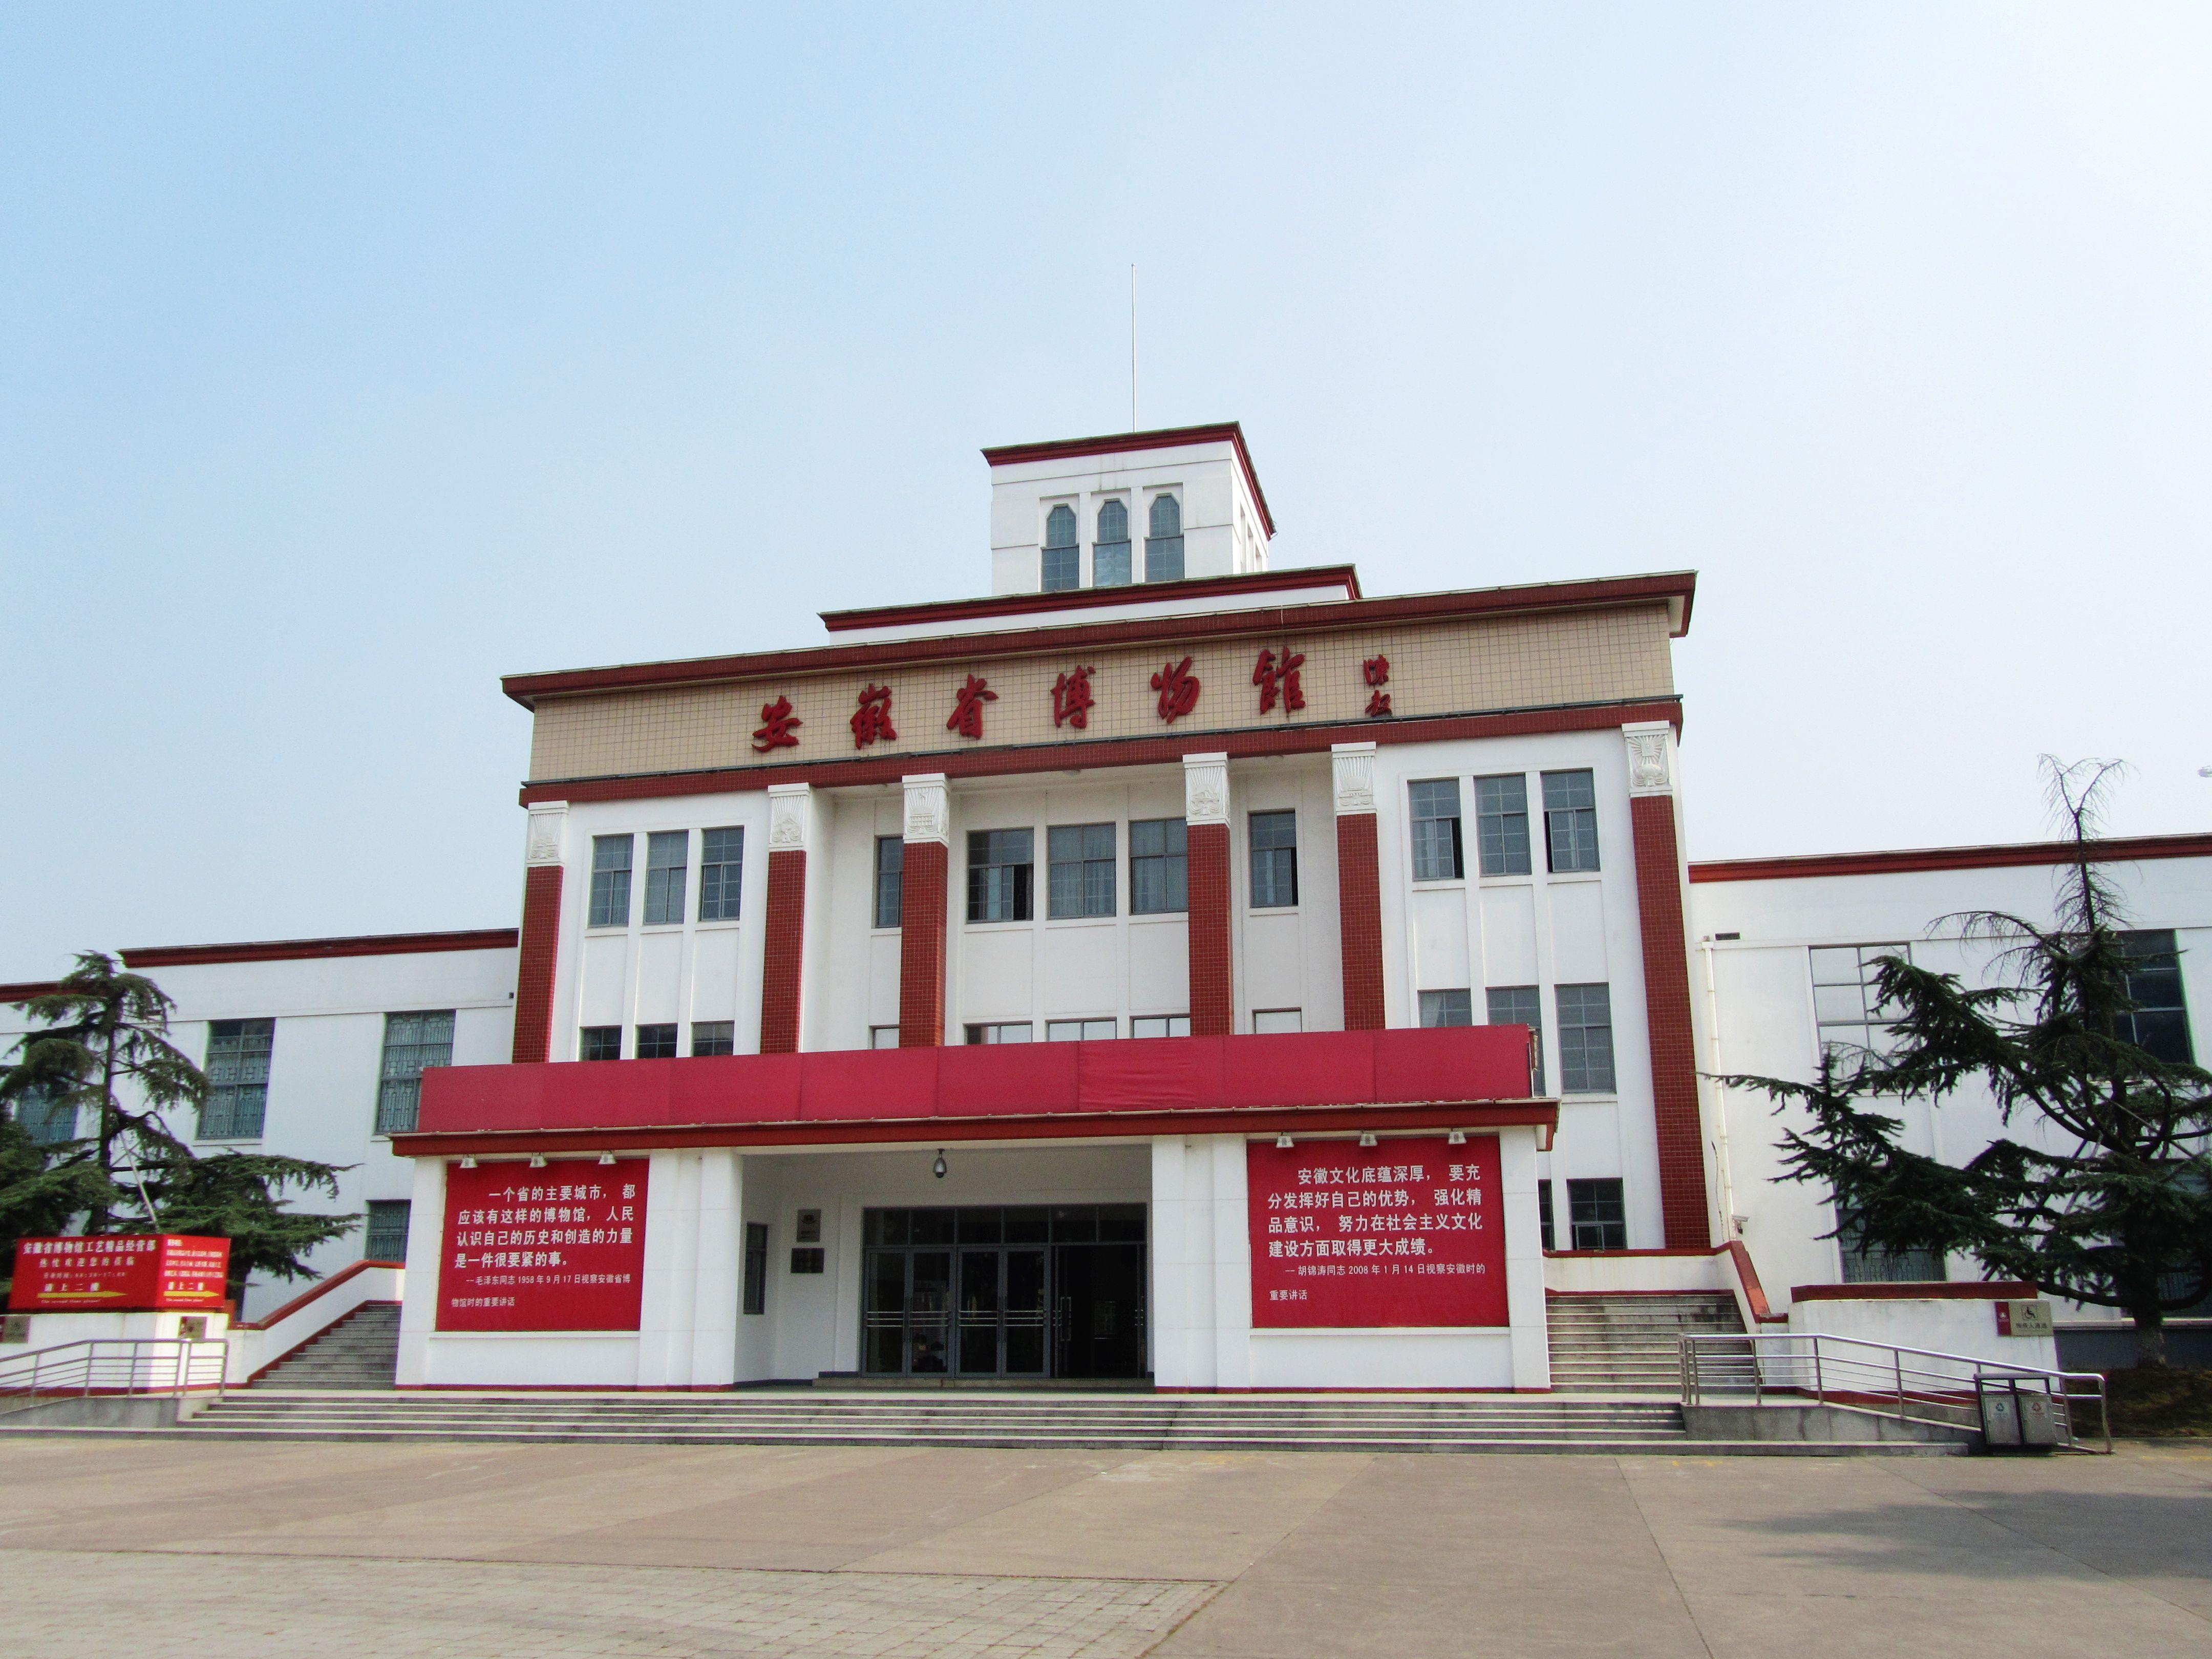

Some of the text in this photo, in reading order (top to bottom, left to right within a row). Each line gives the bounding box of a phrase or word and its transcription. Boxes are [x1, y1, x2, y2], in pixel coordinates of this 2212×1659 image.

[457, 1227, 632, 1247] 认识自己的历史和创造的力量
[1268, 1237, 1433, 1258] 建设方面取得更大成绩。
[455, 1250, 567, 1268] 是一件很要紧的事。
[451, 1296, 515, 1307] 物馆时的重要讲话
[1269, 1289, 1308, 1301] 重要讲话
